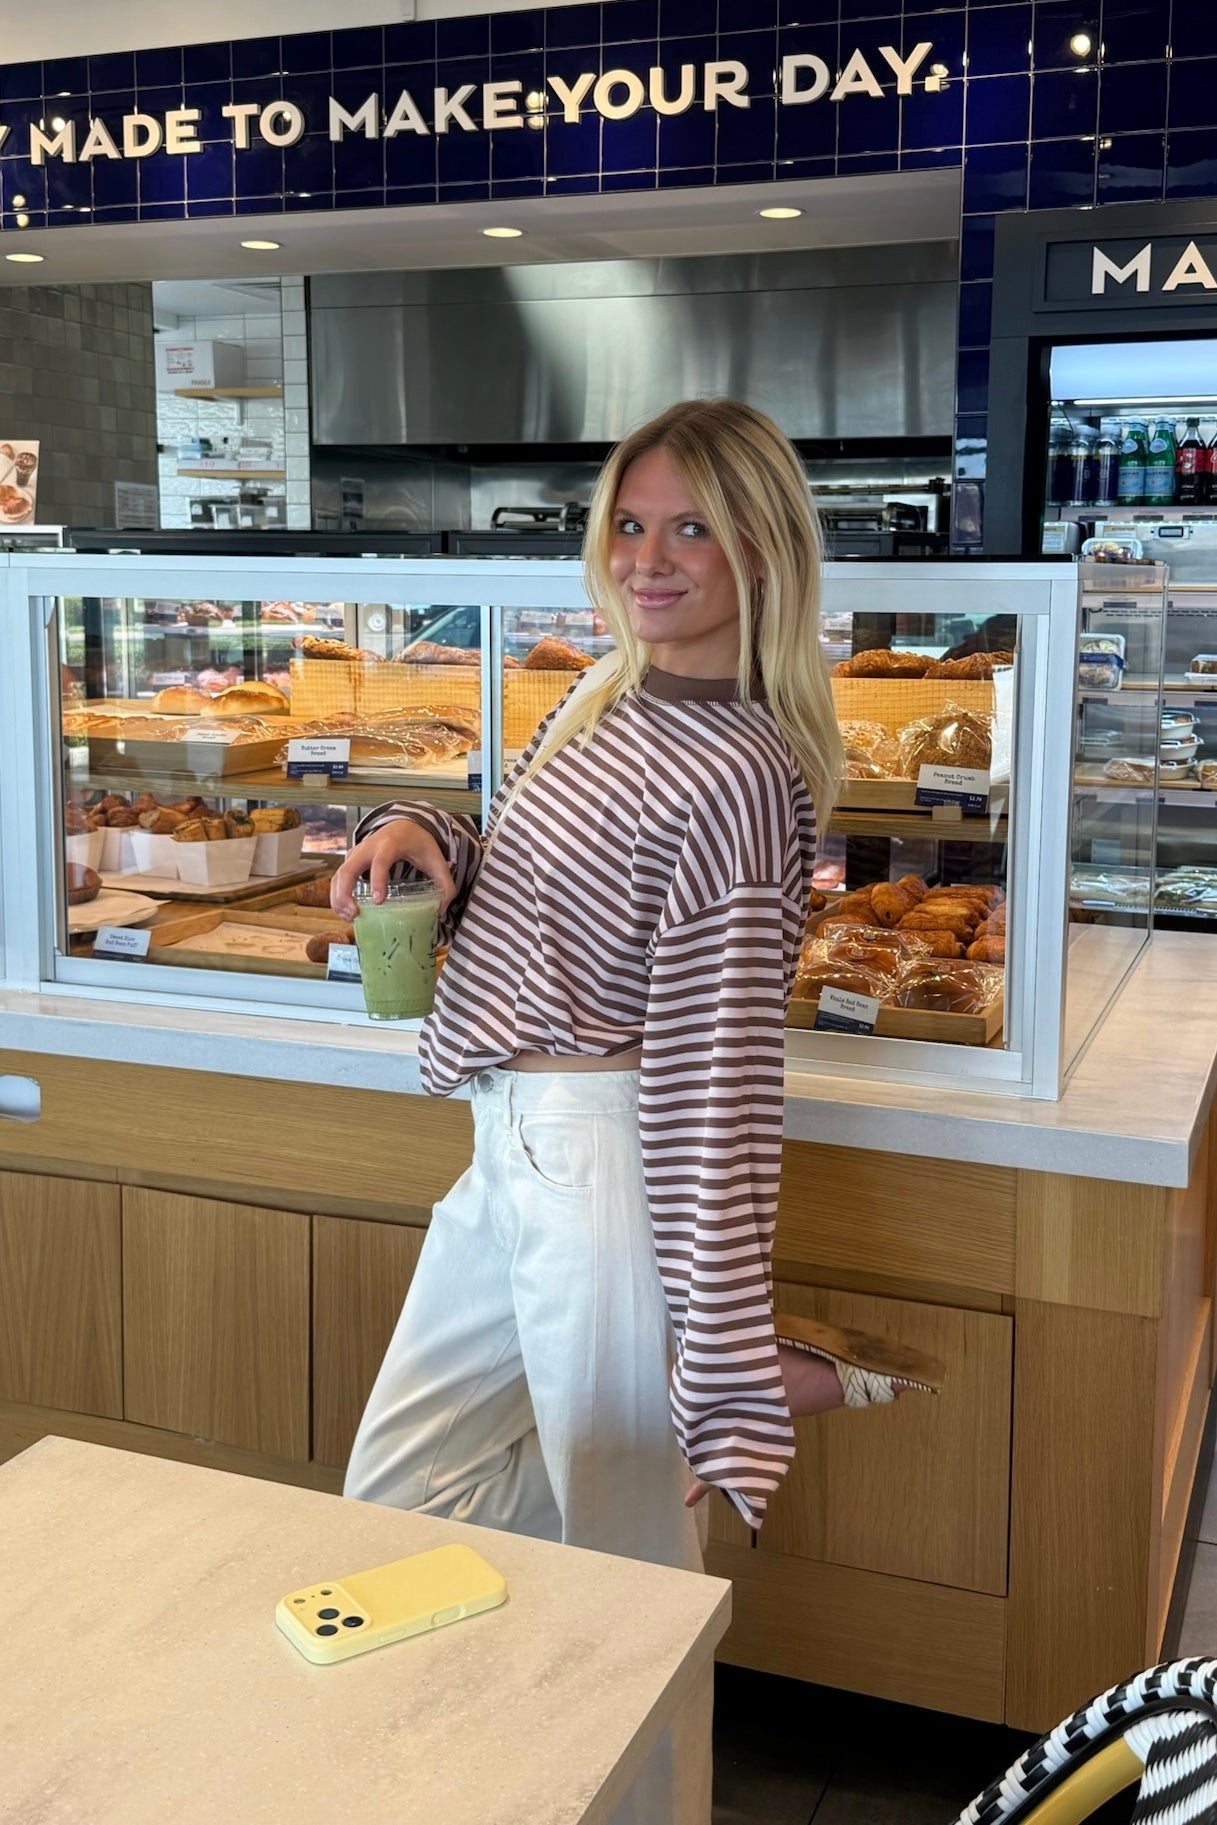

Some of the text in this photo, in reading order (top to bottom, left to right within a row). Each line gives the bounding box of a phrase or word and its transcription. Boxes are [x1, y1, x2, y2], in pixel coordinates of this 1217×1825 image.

[29, 108, 204, 166] MADE
[222, 100, 305, 149] TO
[328, 81, 524, 141] MAKE
[547, 60, 750, 124] YOUR
[780, 41, 945, 105] DAY.
[1091, 240, 1217, 294] MA
